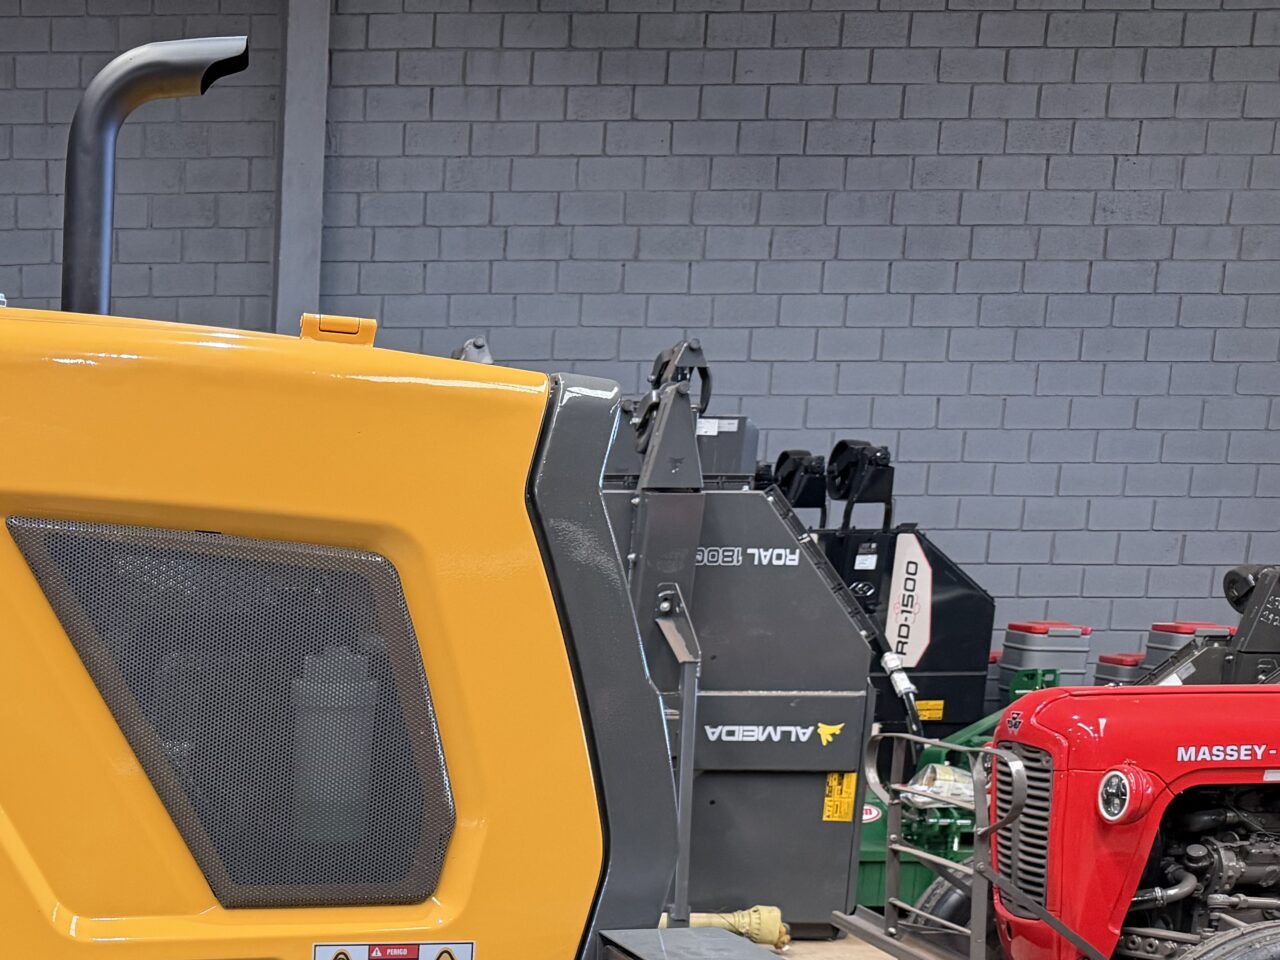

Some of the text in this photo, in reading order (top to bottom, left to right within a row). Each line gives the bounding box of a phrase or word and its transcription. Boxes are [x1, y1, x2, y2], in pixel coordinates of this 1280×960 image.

[895, 561, 919, 656] RD-1500
[704, 725, 815, 743] ALMEIDA
[386, 948, 408, 956] PERIGO
